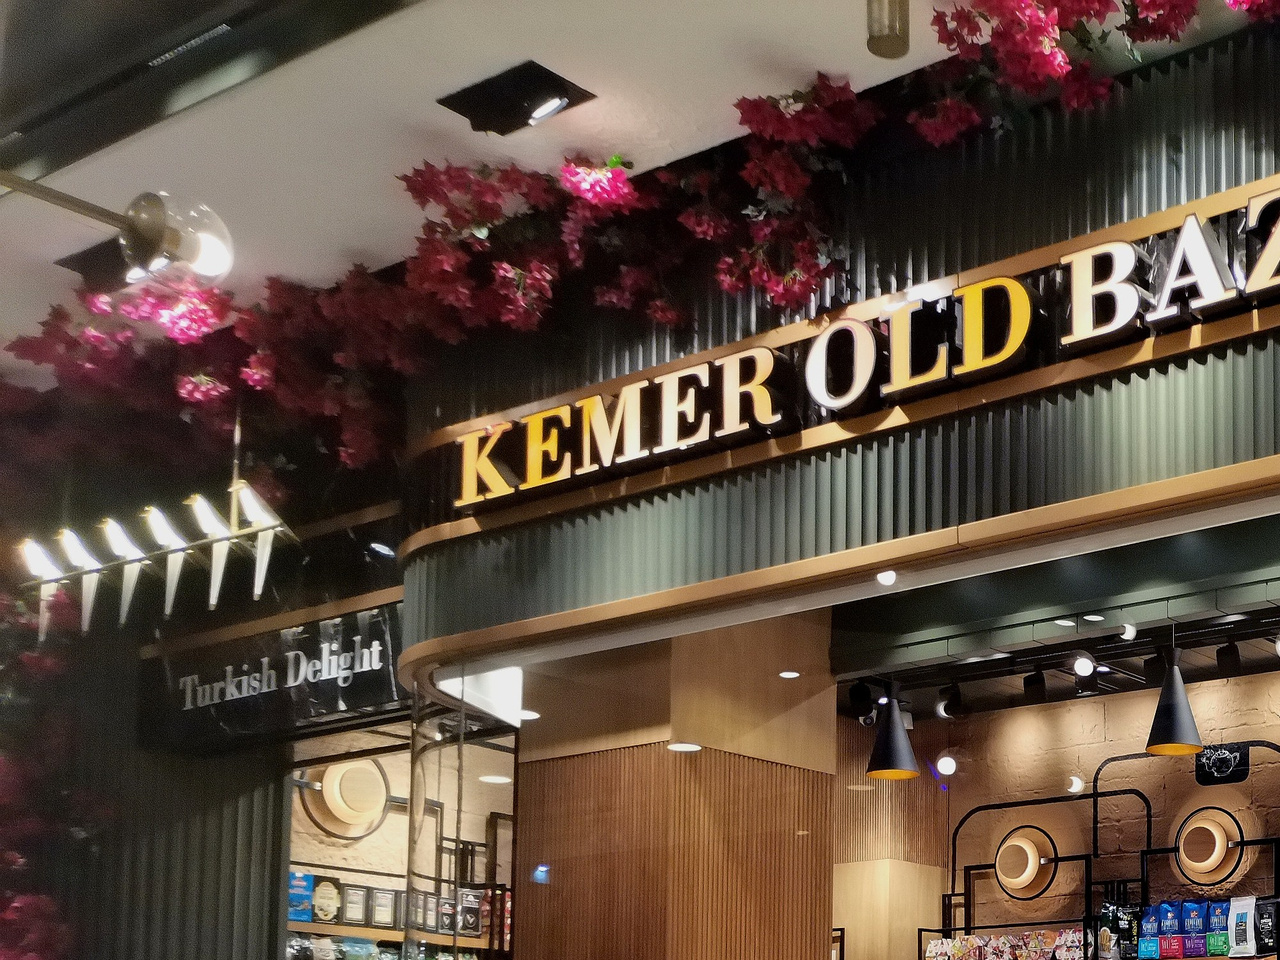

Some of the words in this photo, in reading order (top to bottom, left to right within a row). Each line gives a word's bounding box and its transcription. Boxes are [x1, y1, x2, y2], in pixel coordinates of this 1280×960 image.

[453, 346, 781, 509] KEMER
[804, 276, 1032, 411] OLD
[179, 656, 278, 711] Turkish
[284, 635, 383, 688] Delight
